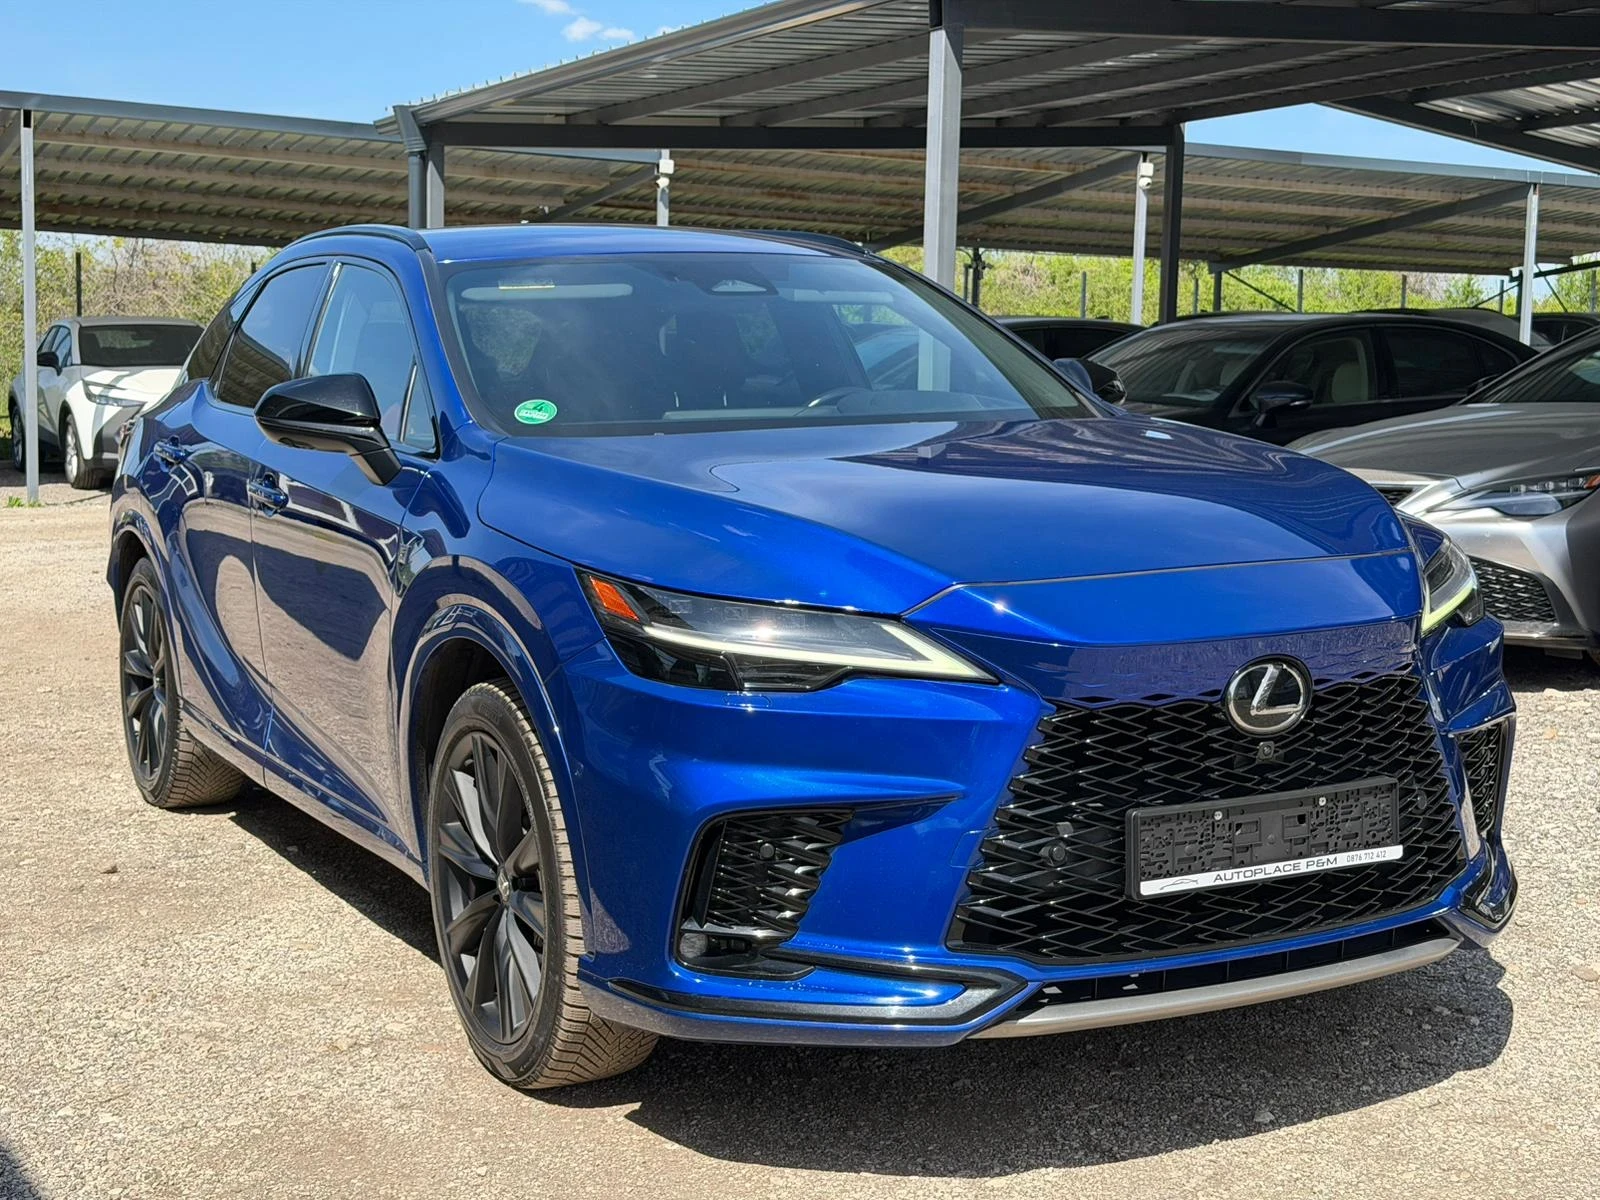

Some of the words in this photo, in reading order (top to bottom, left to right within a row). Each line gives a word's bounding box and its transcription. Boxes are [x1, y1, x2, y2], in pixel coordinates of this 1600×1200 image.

[1213, 863, 1301, 883] AUTOPLACE
[1306, 856, 1338, 869] P&M
[1346, 853, 1363, 863] 0876
[1364, 851, 1375, 861] 712
[1376, 849, 1387, 859] 412
